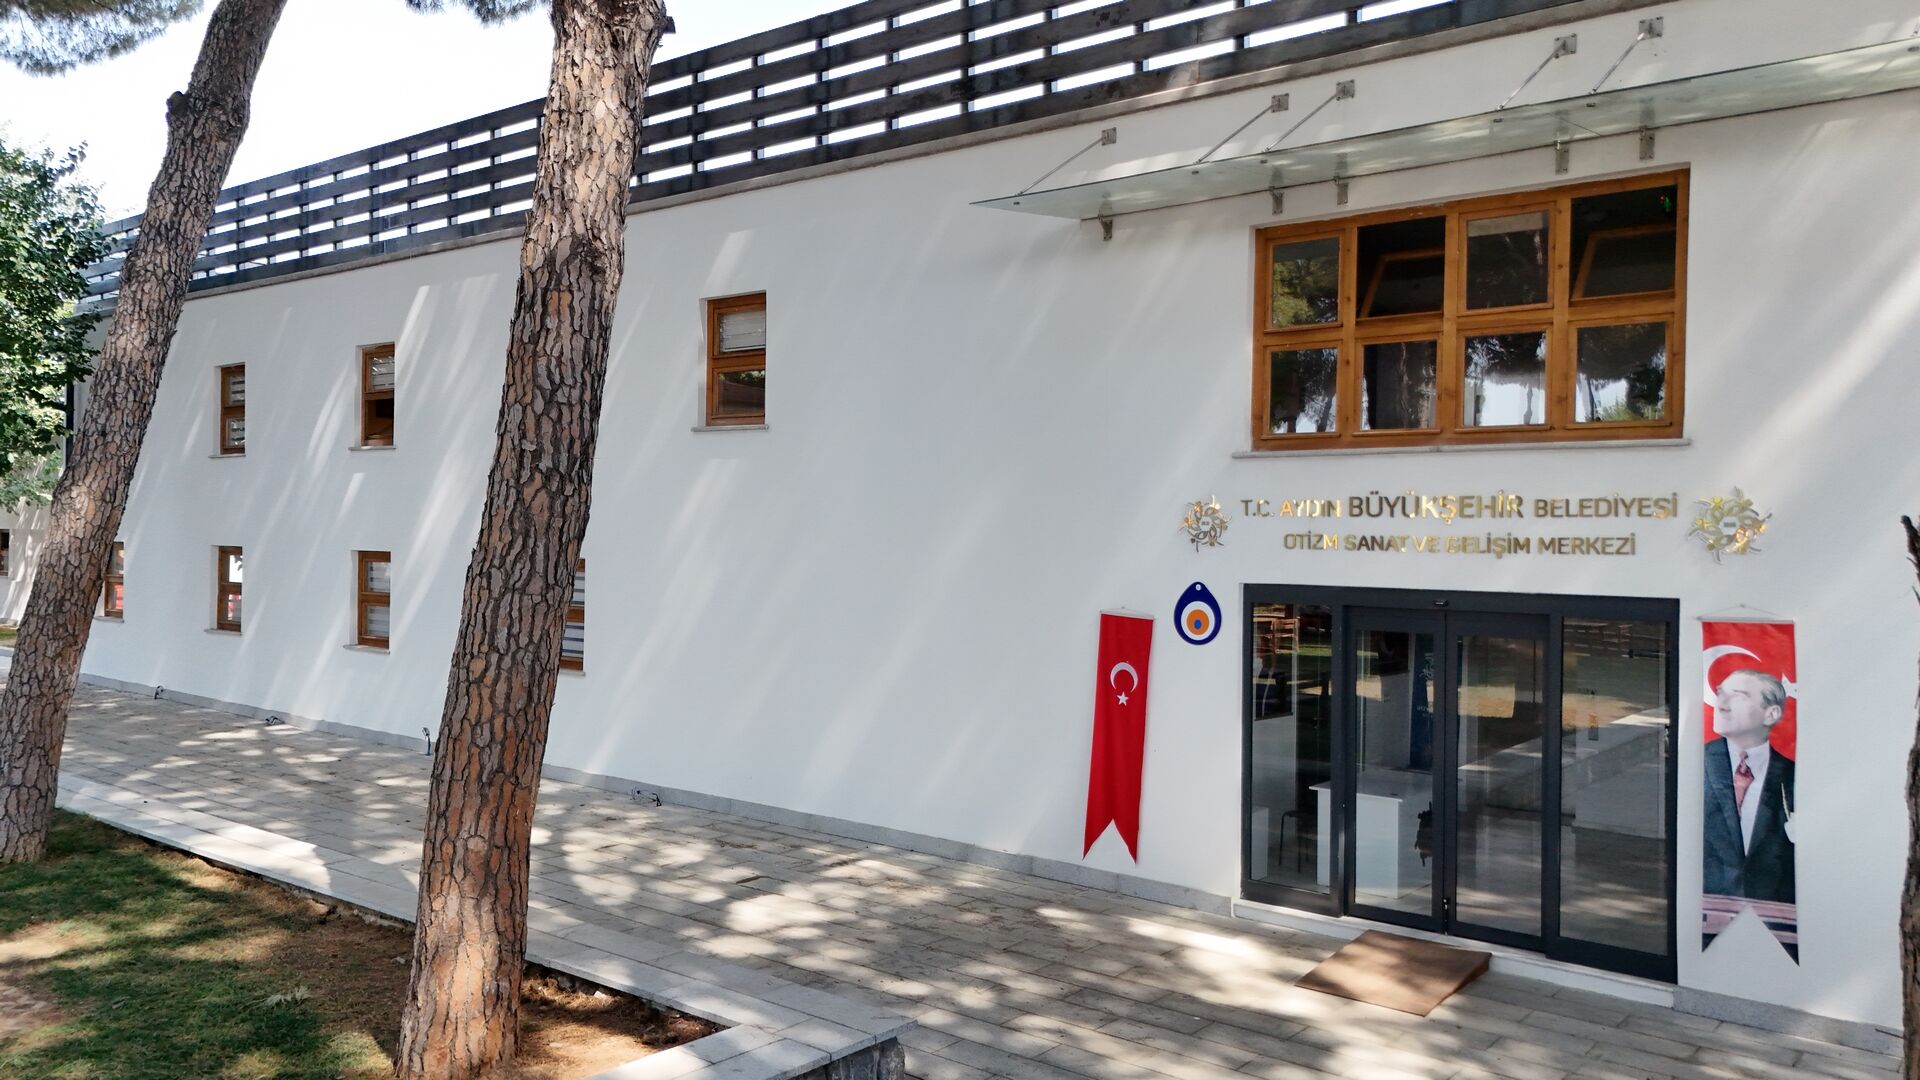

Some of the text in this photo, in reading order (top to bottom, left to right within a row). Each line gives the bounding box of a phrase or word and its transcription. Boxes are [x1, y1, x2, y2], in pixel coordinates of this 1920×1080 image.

[1240, 490, 1678, 524] T.C. AYDIN BÜYÜKŞEHİR BELEDİYESİ
[1284, 530, 1636, 559] OTİZM SANAT VE GELİŞİM MERKEZİ
